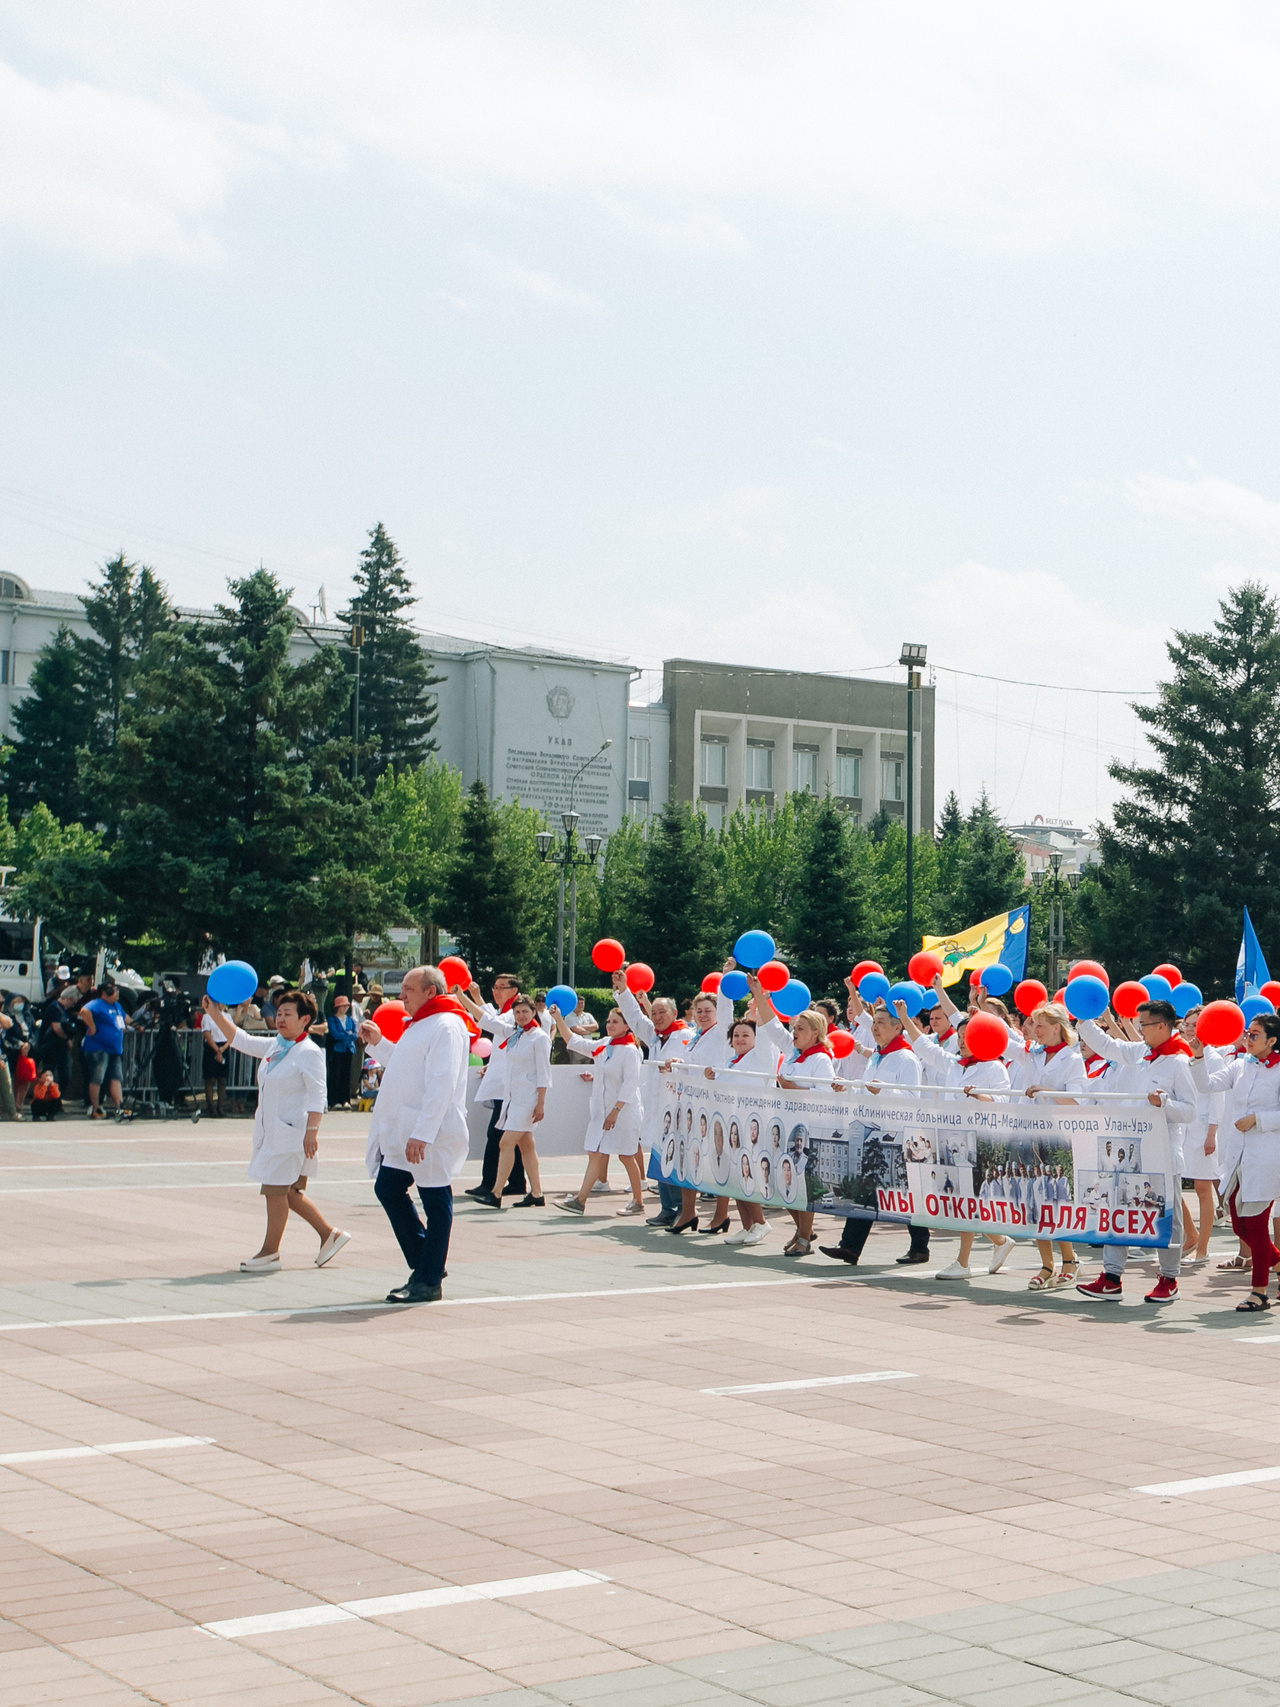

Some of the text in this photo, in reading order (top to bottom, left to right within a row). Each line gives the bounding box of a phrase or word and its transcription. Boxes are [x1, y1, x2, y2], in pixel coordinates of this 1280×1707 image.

[548, 736, 572, 746] УКАЗ
[737, 1096, 782, 1110] учреждение
[784, 1100, 849, 1116] здравоохранения
[853, 1105, 913, 1122] «Клиническая
[916, 1108, 962, 1125] больница
[967, 1112, 1053, 1131] «РЖД-Медицина»
[1058, 1119, 1099, 1133] города
[1104, 1117, 1153, 1134] Улан-Удэ»
[878, 1190, 1158, 1235] МЫ ОТКРЫТЫ ДЛЯ ВСЕХ
